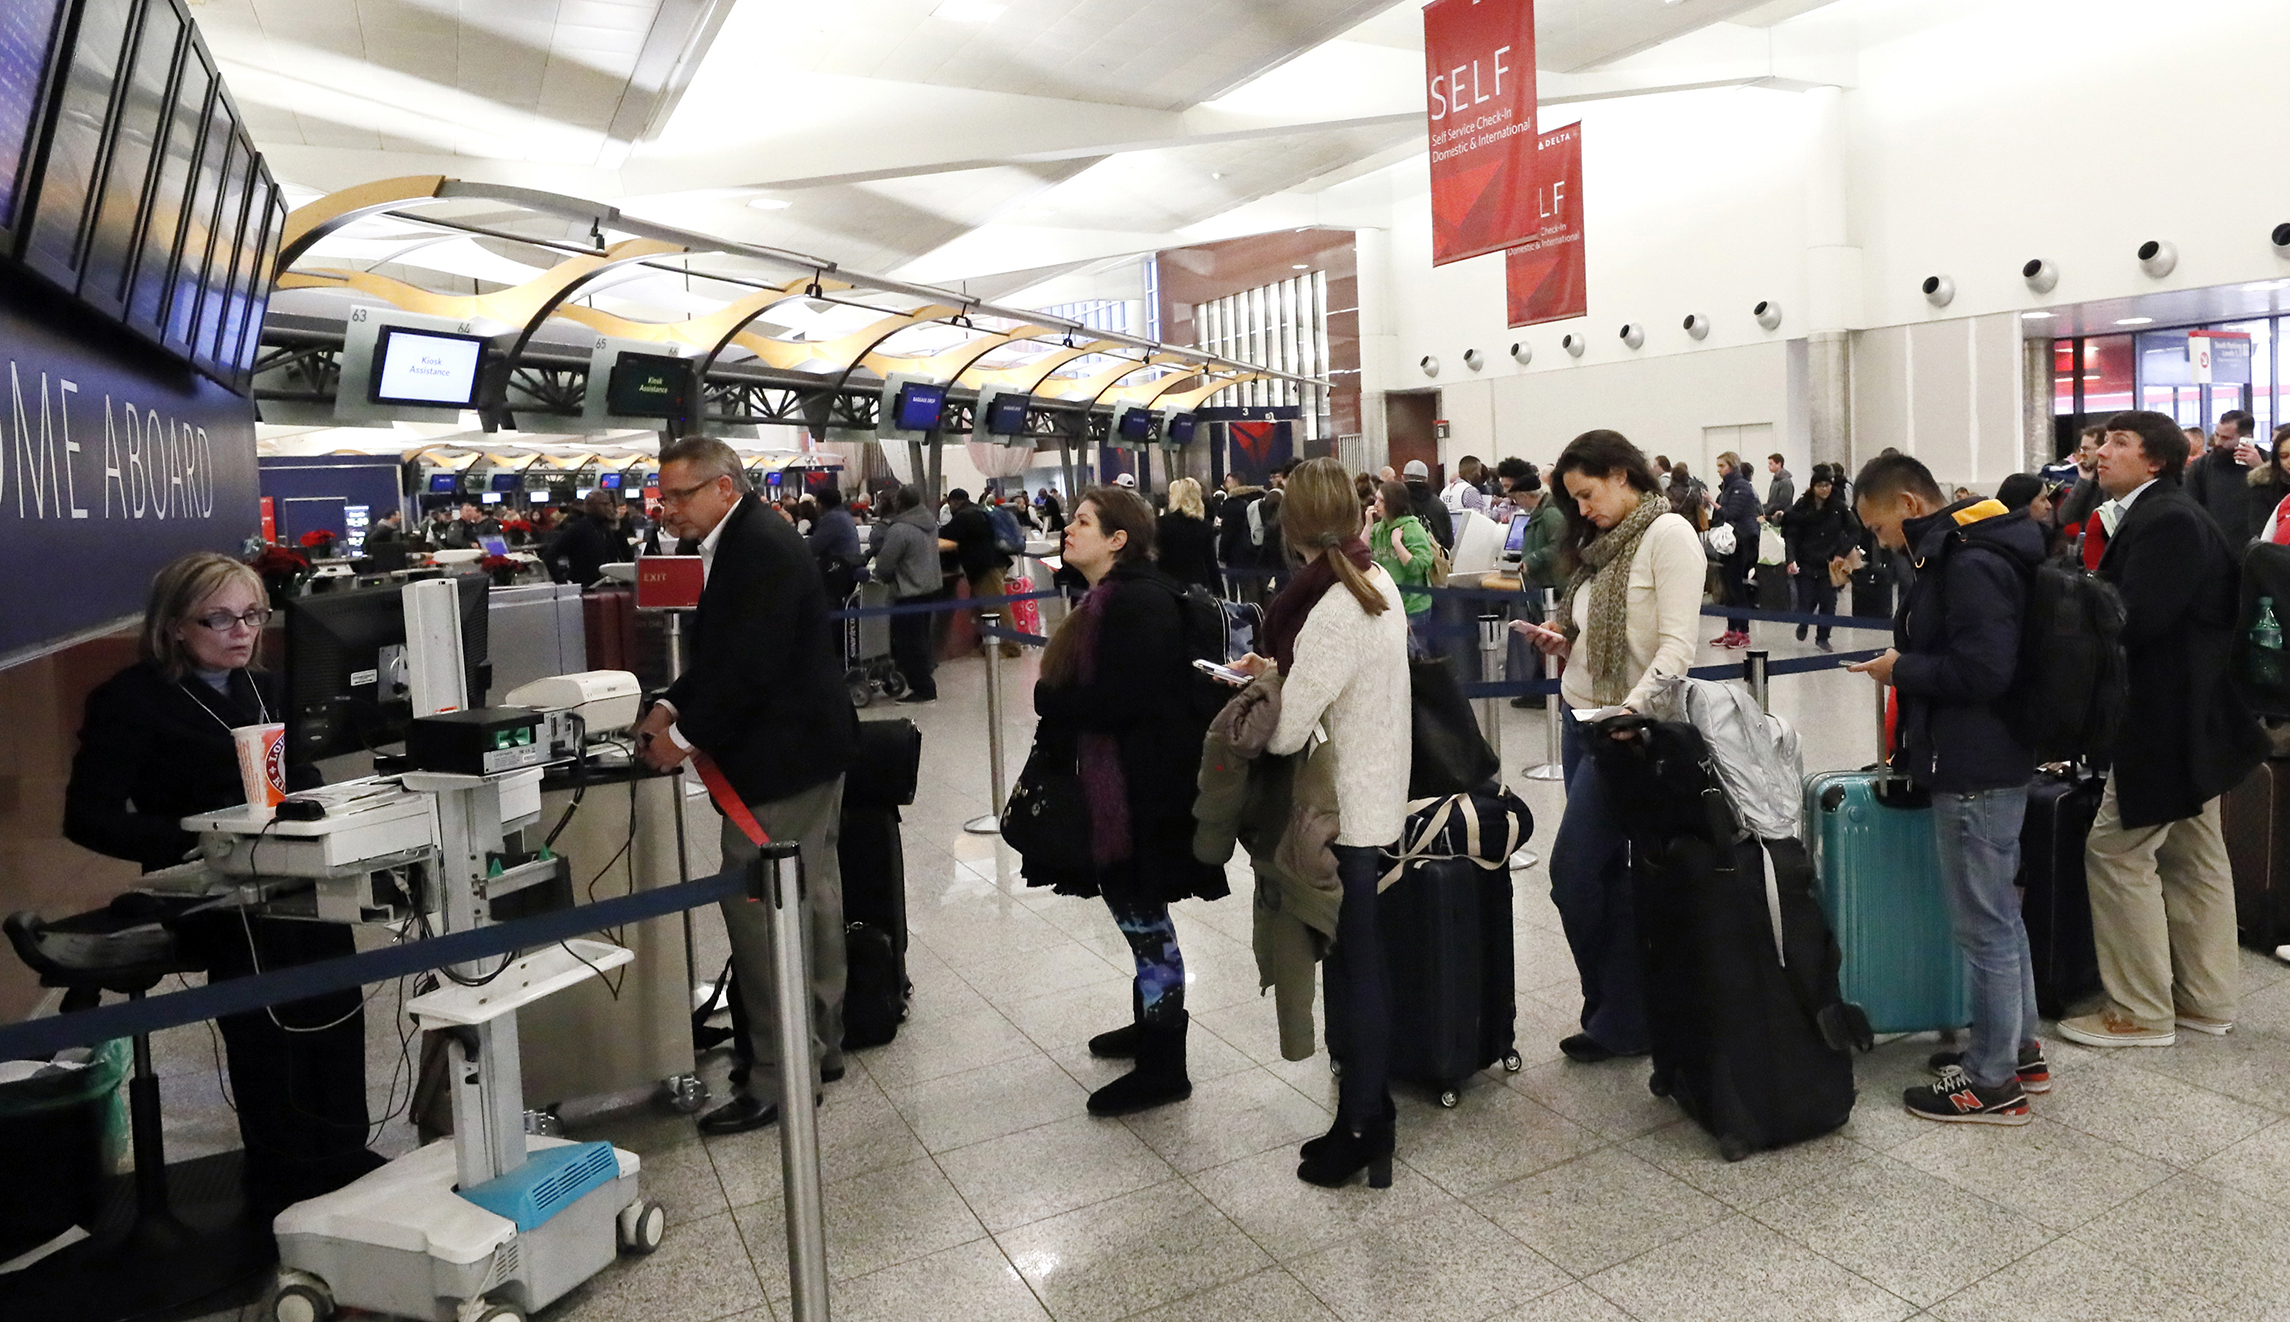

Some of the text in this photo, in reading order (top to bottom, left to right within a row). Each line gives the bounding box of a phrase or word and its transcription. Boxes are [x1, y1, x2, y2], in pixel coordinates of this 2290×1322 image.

[1430, 45, 1511, 121] SELF
[1432, 107, 1513, 147] Self Service Check-In
[1432, 116, 1532, 163] Domestic & International
[1545, 133, 1571, 148] DELTA
[1507, 231, 1580, 257] Domestic & International
[352, 309, 471, 334] 63 64
[595, 338, 607, 350] 65
[421, 355, 443, 366] Kiosk
[409, 365, 451, 377] Assistance
[647, 376, 663, 385] Kiosk
[638, 384, 669, 394] Assistance
[0, 360, 213, 520] ME ABOARD
[643, 573, 667, 582] EXIT
[1949, 1089, 1984, 1113] N
